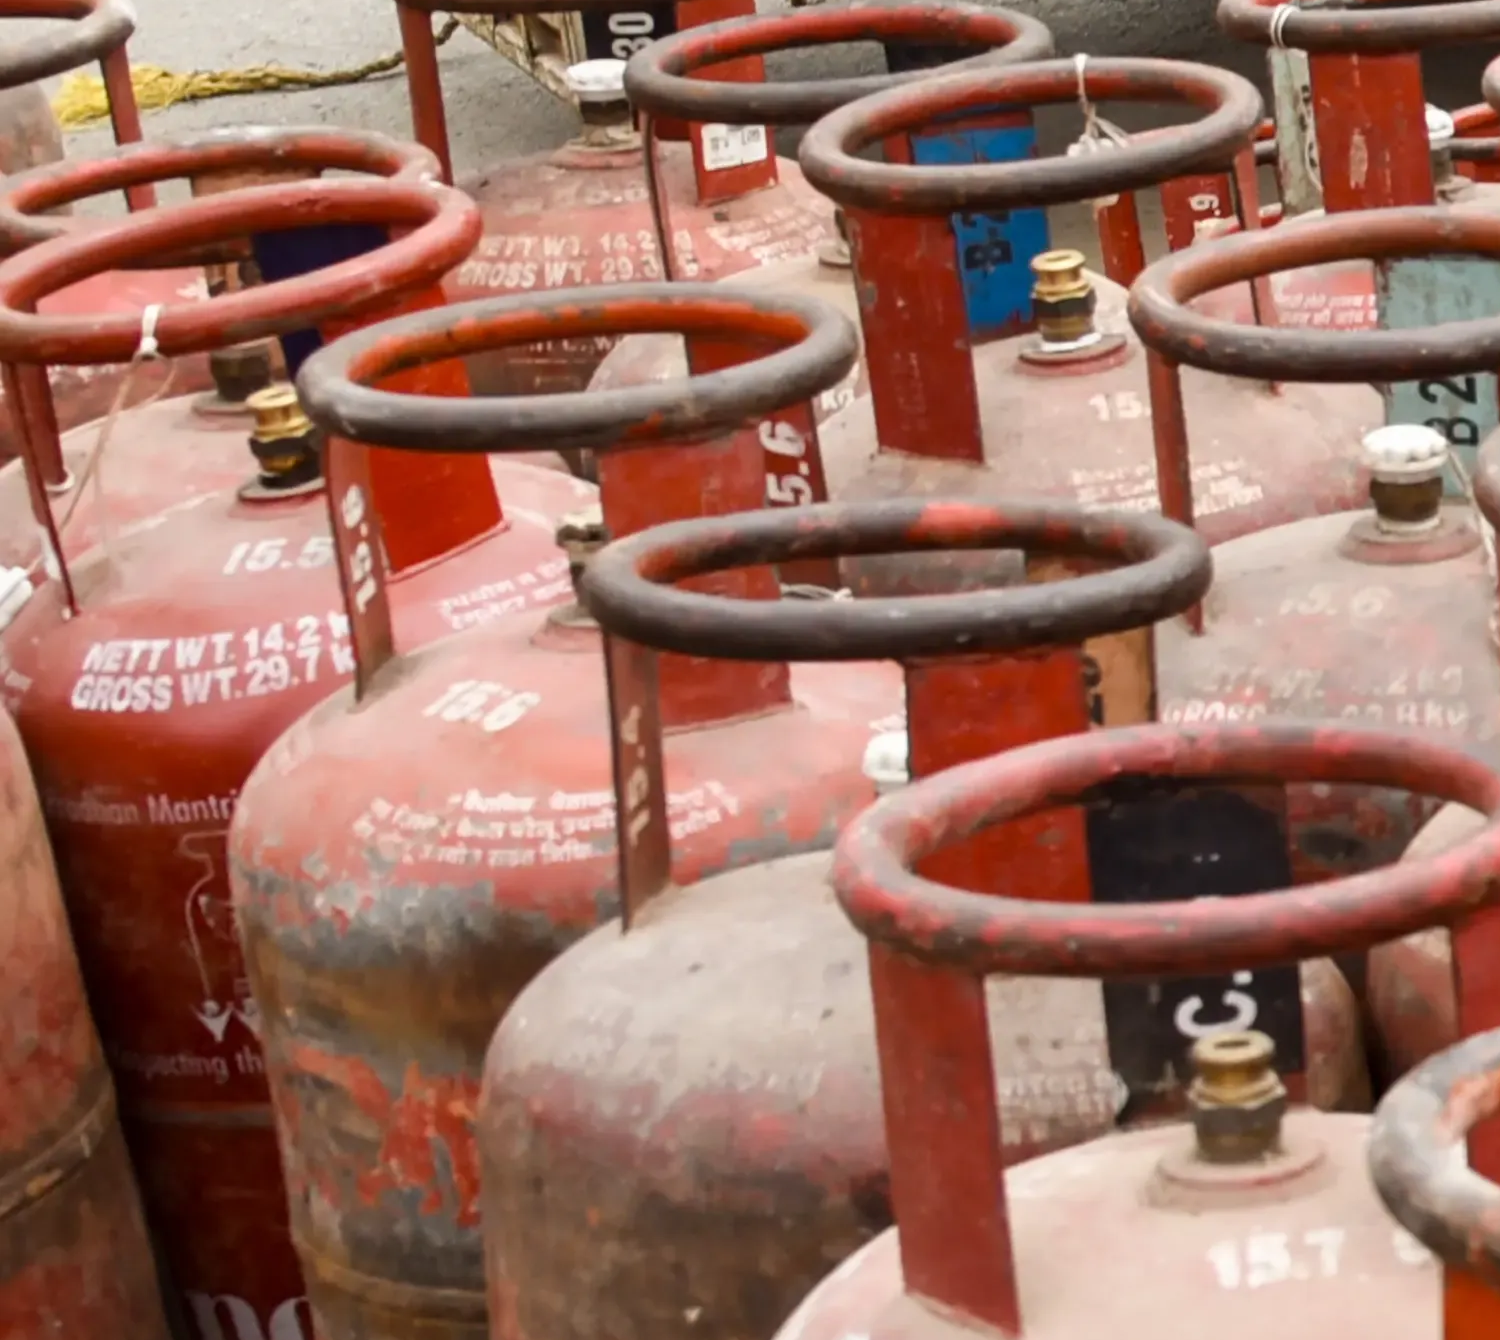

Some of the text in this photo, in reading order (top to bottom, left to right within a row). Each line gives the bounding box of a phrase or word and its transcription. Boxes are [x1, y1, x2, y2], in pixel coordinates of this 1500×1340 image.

[1088, 392, 1153, 422] 15.
[761, 419, 813, 509] 5.6
[81, 614, 323, 673] NETT WT. 14.2
[70, 643, 323, 713] GROSS WT. 29.7
[1205, 1229, 1348, 1289] 15.7
